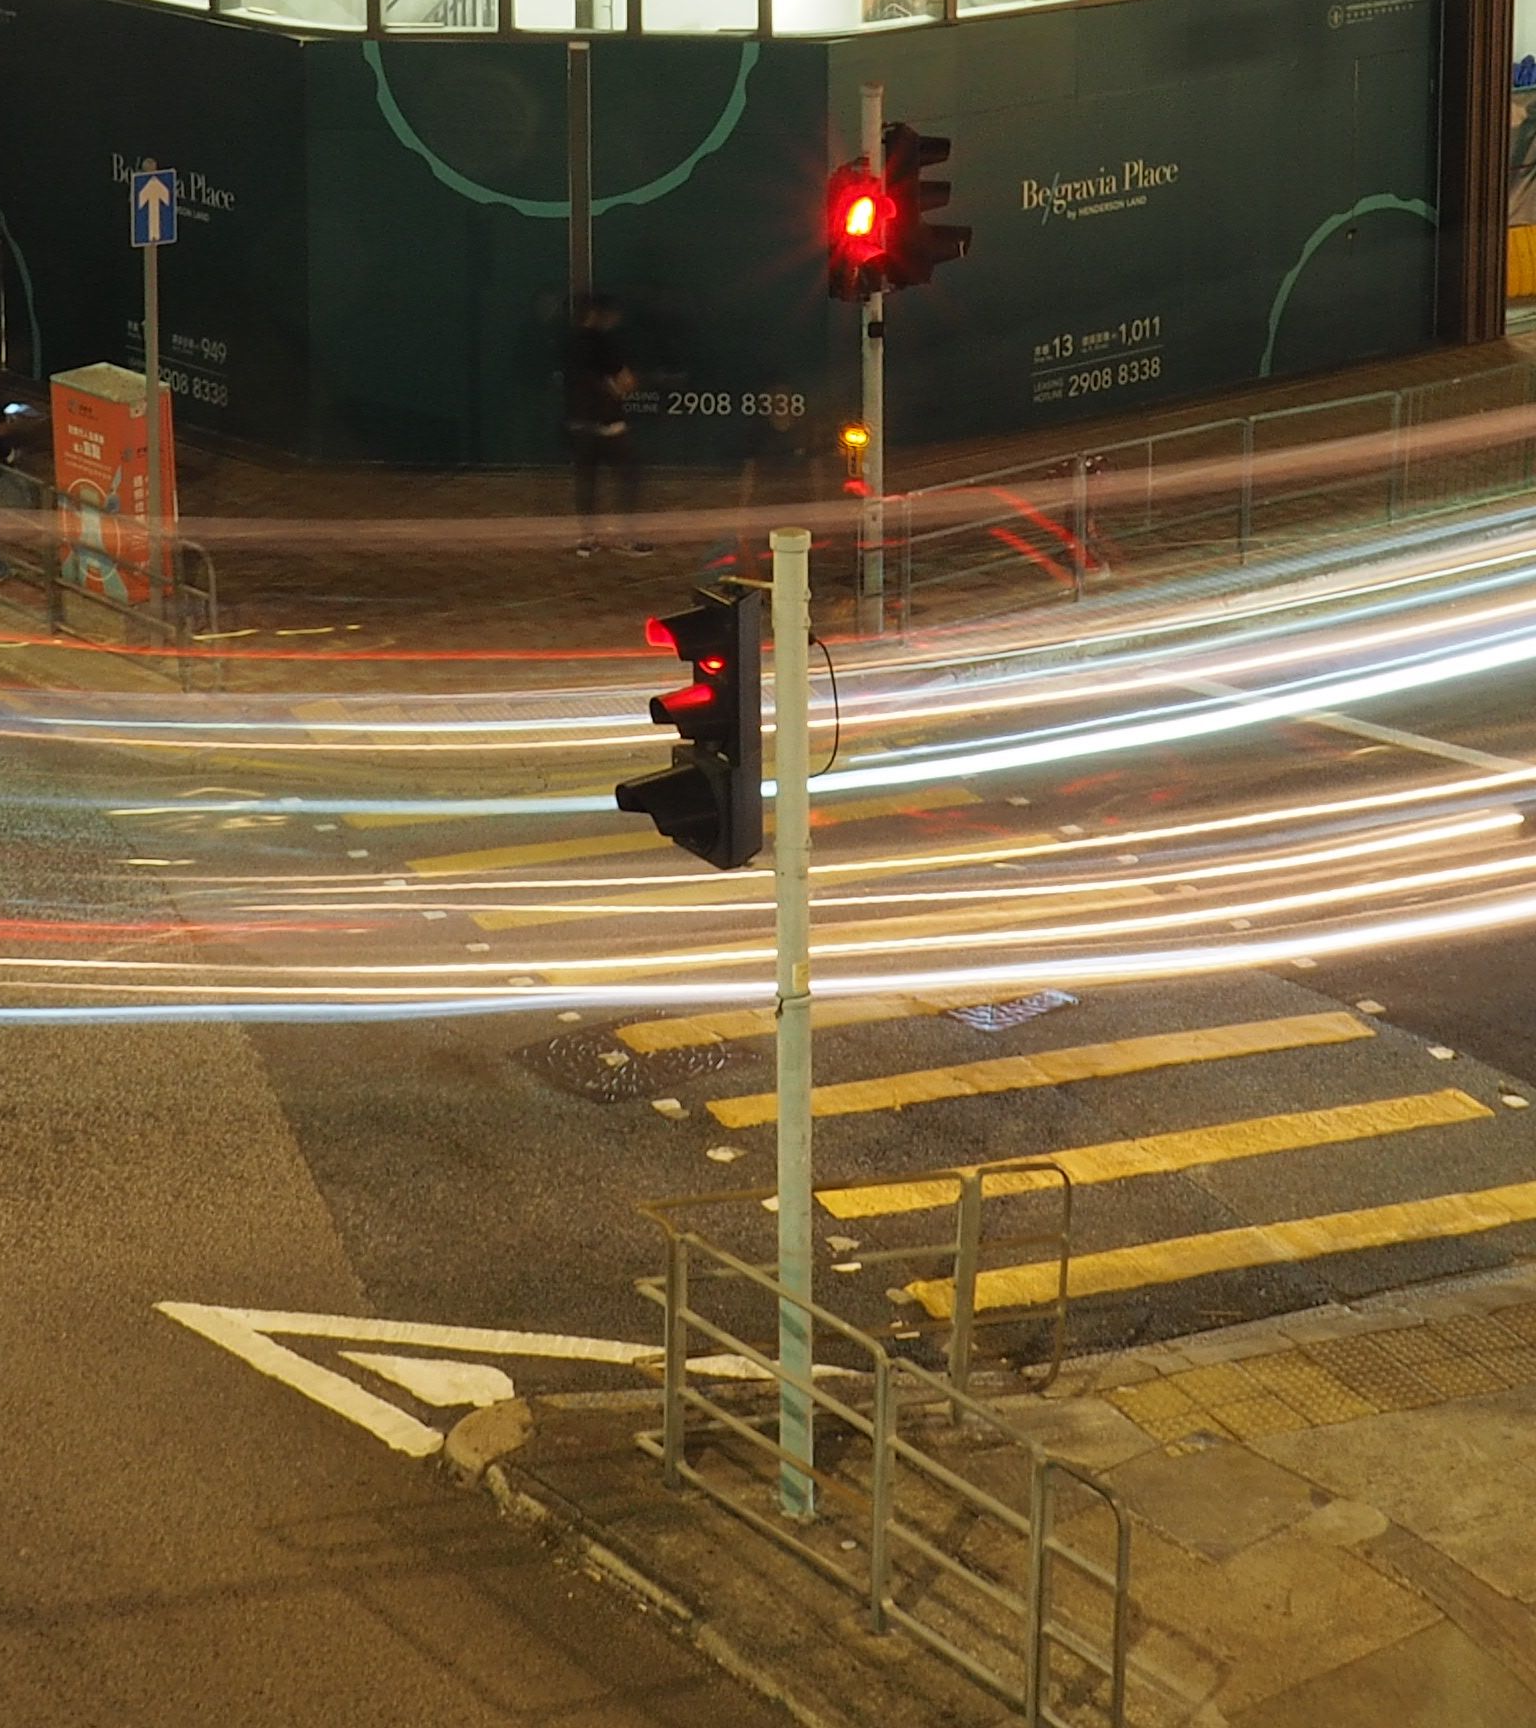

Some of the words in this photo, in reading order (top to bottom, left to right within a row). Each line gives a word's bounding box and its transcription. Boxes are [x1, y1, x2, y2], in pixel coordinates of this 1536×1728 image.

[190, 171, 235, 211] Place
[1122, 159, 1180, 192] Place
[1066, 209, 1077, 221] by
[1077, 200, 1125, 218] HENDERSON
[1125, 194, 1148, 208] LAND
[201, 336, 227, 365] 949
[1052, 334, 1073, 359] 13
[1118, 315, 1161, 347] 1,011
[192, 376, 228, 408] 8338
[1068, 367, 1112, 398] 2908
[1118, 356, 1161, 385] 8338
[667, 391, 732, 416] 2908
[740, 392, 806, 418] 8338
